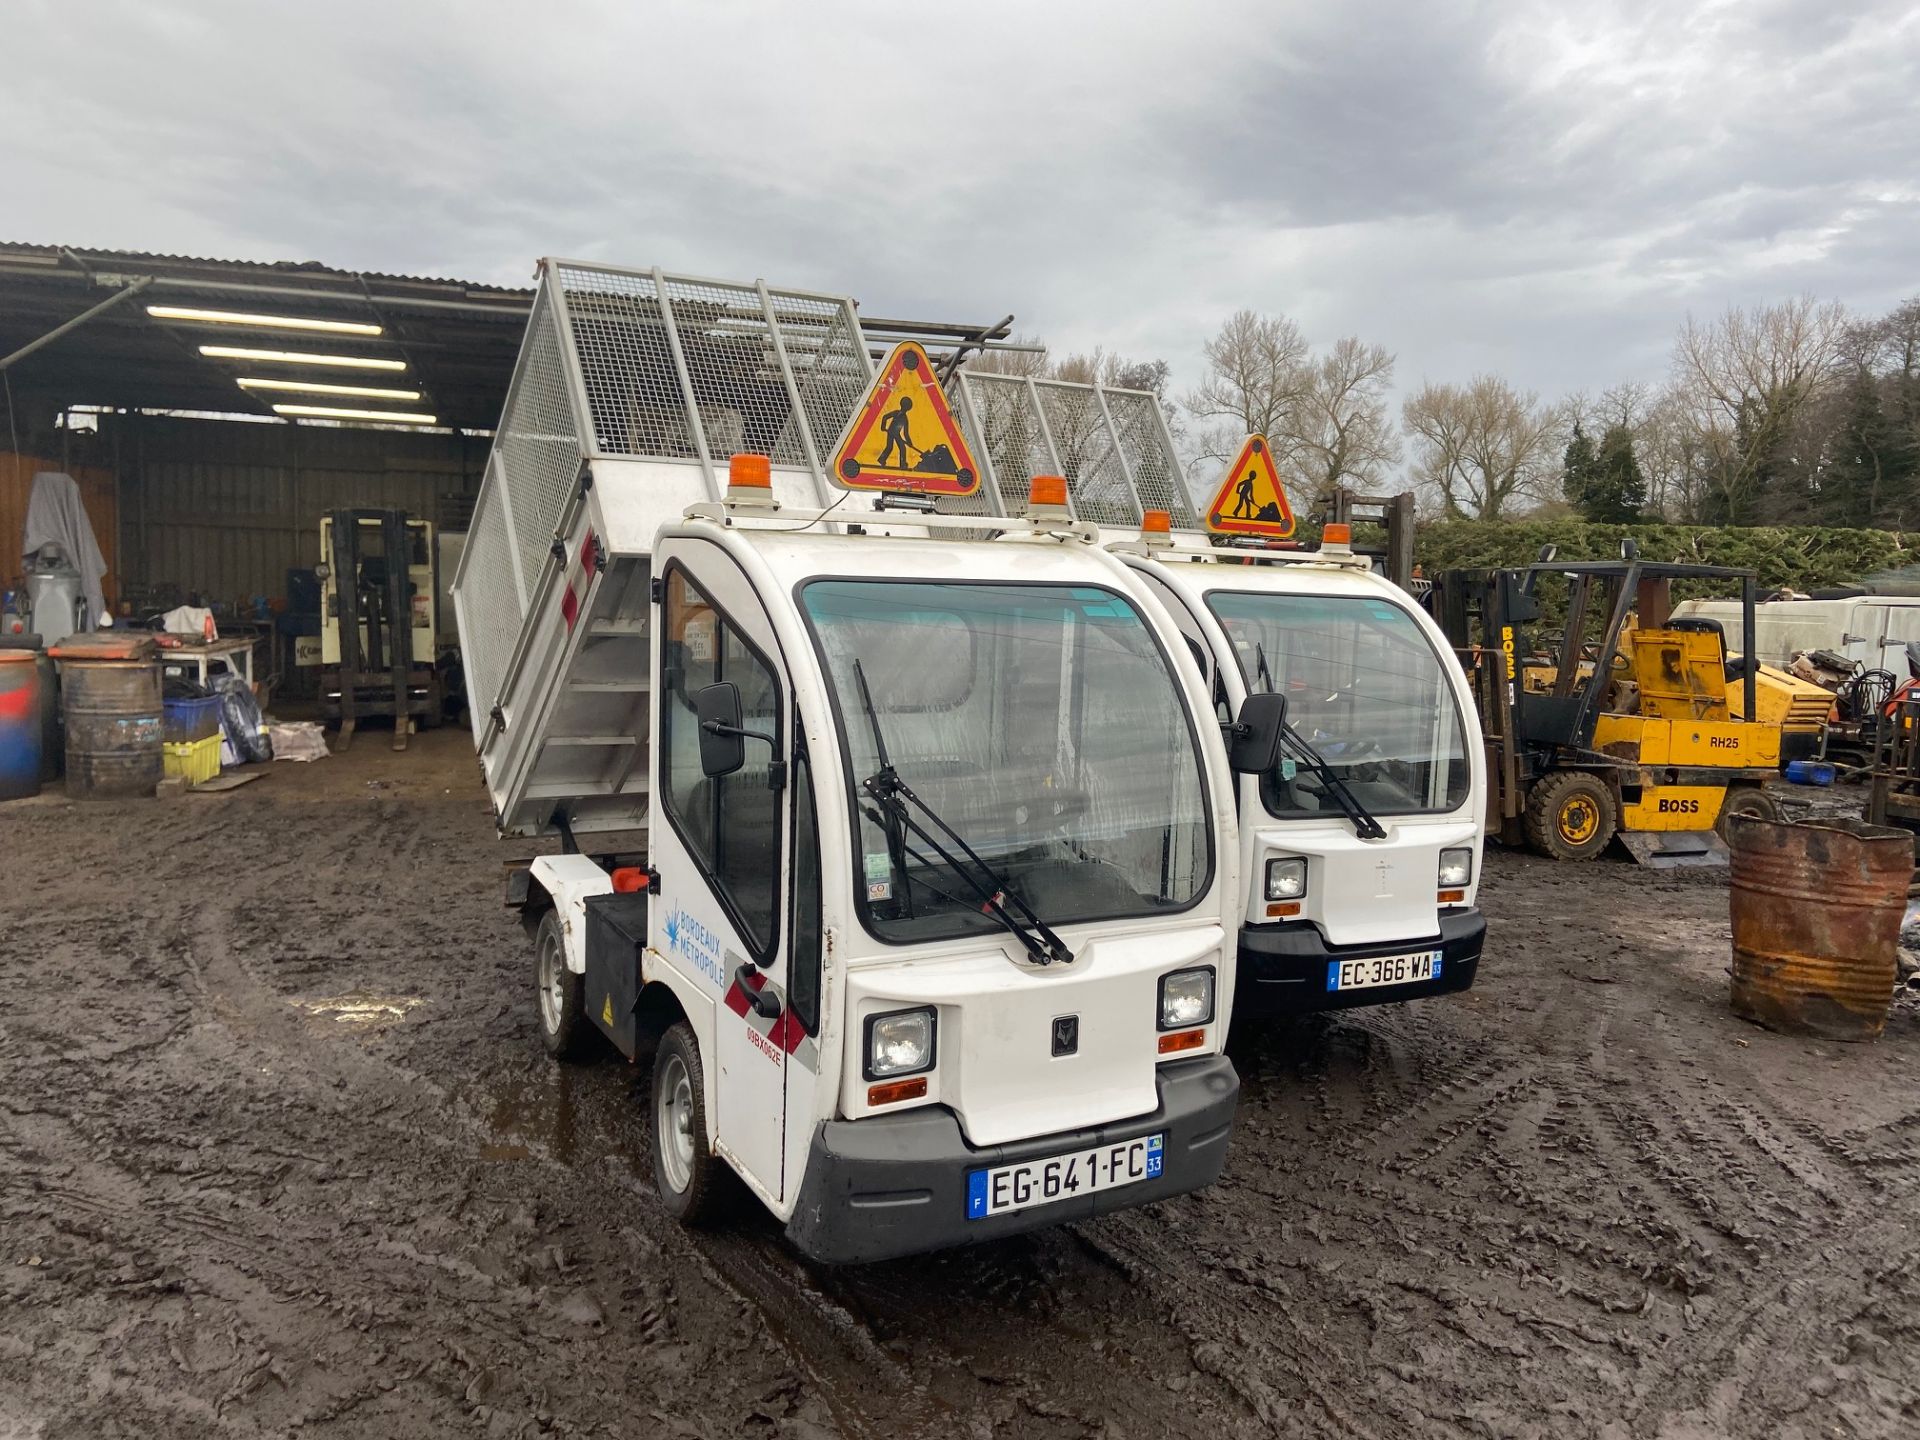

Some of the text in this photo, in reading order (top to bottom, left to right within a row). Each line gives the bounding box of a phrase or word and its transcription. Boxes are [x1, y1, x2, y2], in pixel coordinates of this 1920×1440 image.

[1502, 626, 1515, 679] BOSS
[1710, 737, 1739, 749] RH25
[1659, 799, 1699, 813] BOSS
[681, 911, 720, 958] BORDEAUX
[680, 936, 724, 988] MÉTROPOLE
[1341, 955, 1431, 986] EC-366-WA
[1432, 964, 1442, 975] 33
[974, 1197, 982, 1210] F
[992, 1143, 1144, 1209] EG-641-FC
[1147, 1156, 1162, 1173] 33
